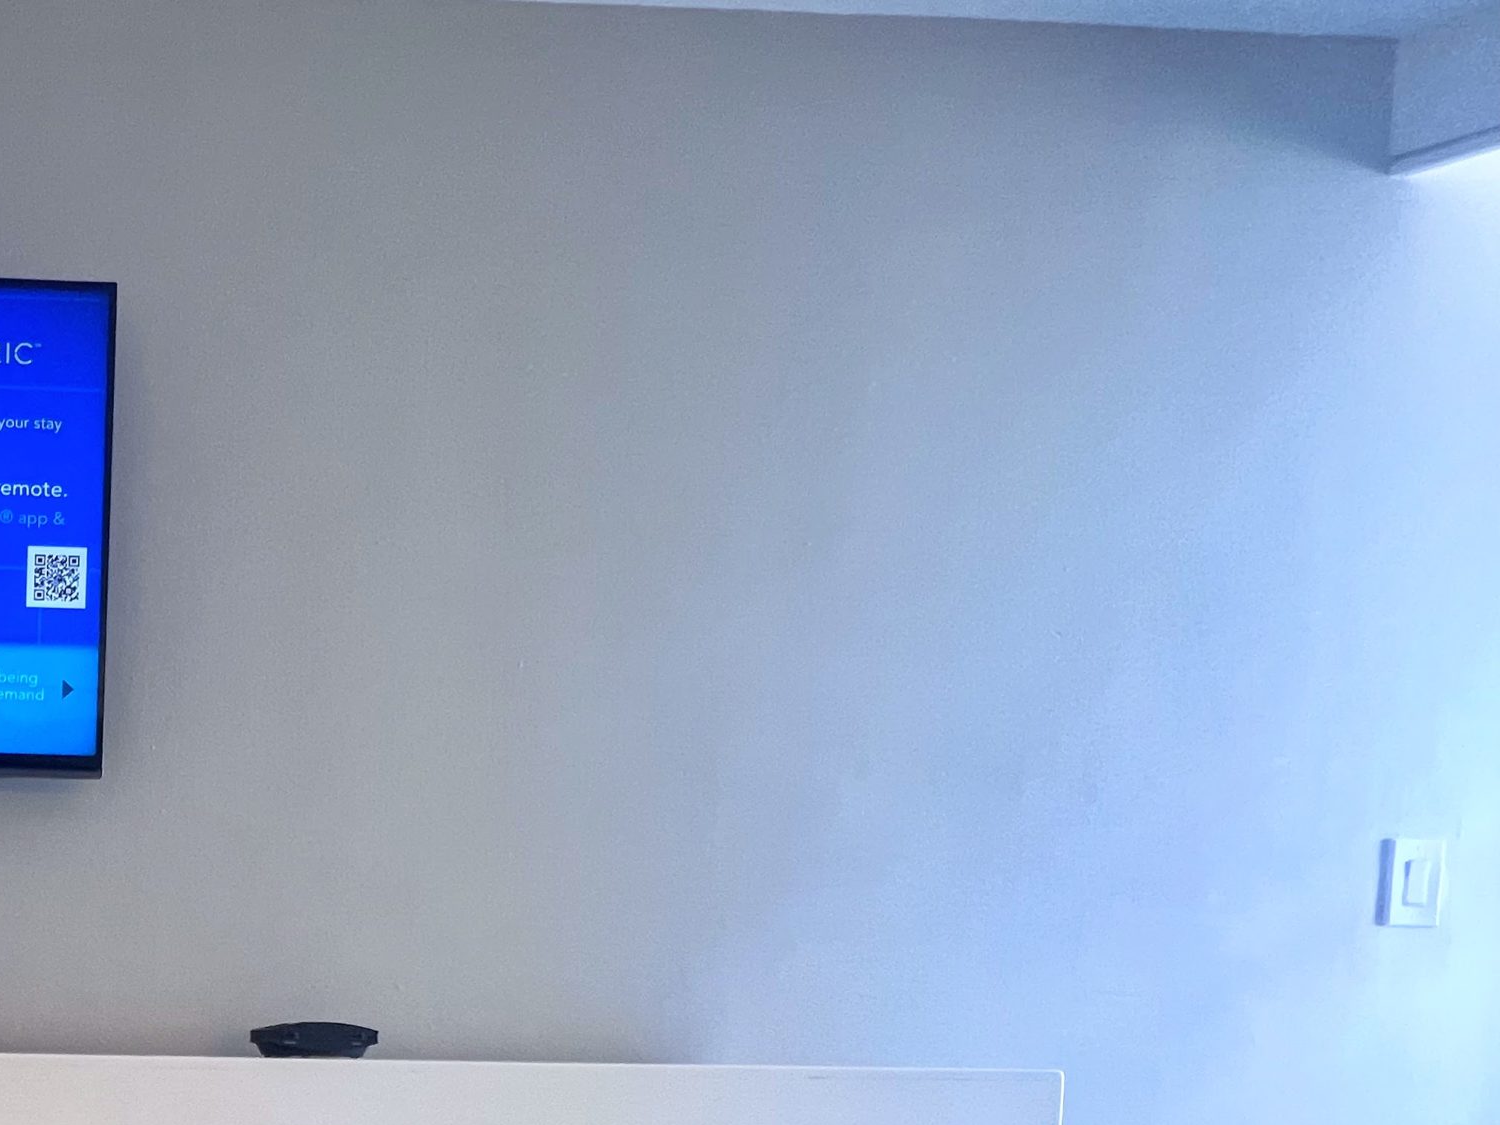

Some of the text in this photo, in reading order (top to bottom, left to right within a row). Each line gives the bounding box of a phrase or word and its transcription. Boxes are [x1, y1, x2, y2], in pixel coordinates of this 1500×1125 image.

[33, 416, 62, 433] stay
[18, 513, 48, 528] app
[53, 512, 65, 525] &
